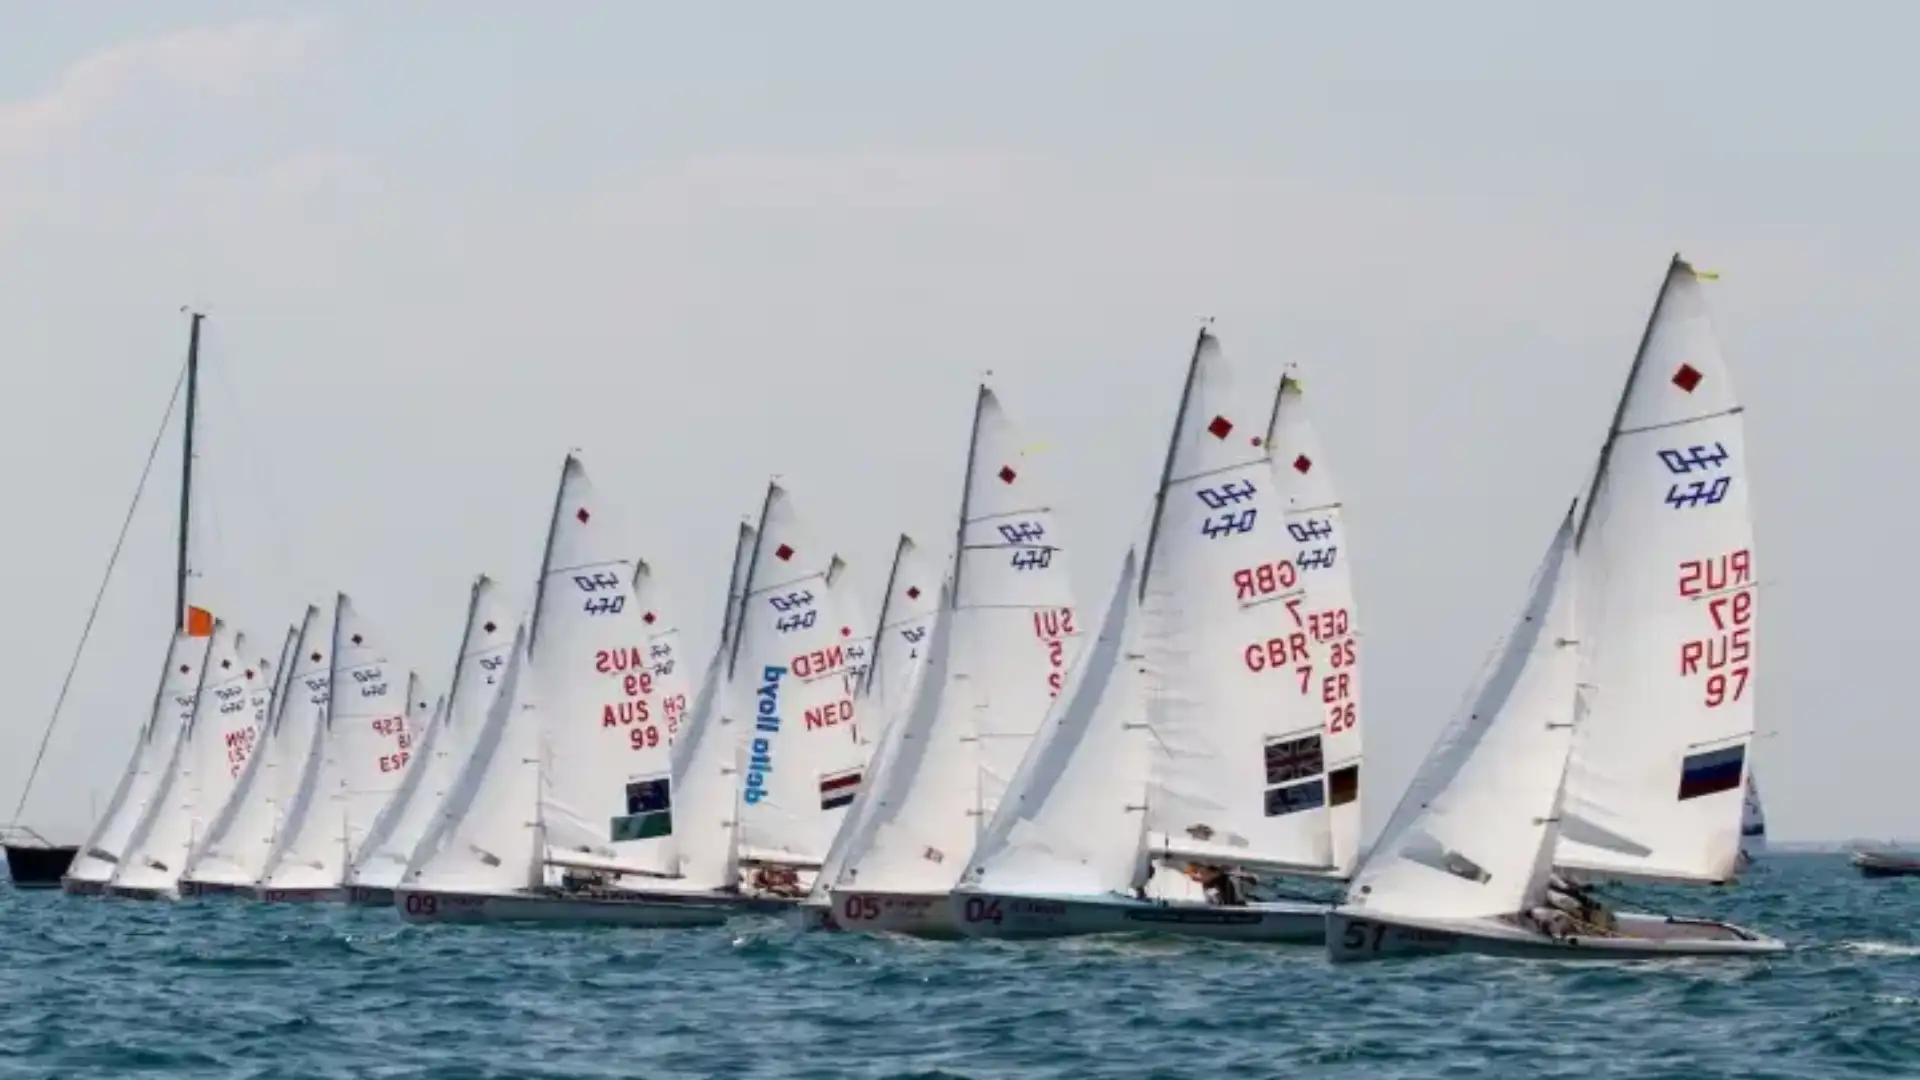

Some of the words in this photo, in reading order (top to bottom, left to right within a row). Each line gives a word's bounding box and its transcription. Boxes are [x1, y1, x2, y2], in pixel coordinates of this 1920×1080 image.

[1664, 477, 1731, 509] 470
[1202, 509, 1257, 539] 470
[1010, 548, 1052, 570] 470
[1296, 547, 1337, 570] 470
[584, 595, 626, 615] 470
[776, 610, 816, 632] 470
[1245, 633, 1310, 672] GBR
[1680, 628, 1750, 676] RUS
[1296, 666, 1312, 695] 7
[1323, 673, 1350, 703] ER
[1705, 667, 1750, 707] 97
[603, 700, 649, 727] AUS
[804, 699, 854, 731] NED
[1330, 702, 1355, 733] 26
[630, 725, 659, 750] 99
[407, 894, 438, 915] 09
[844, 895, 880, 919] 05
[965, 897, 1003, 924] 04
[1344, 921, 1387, 951] 51
